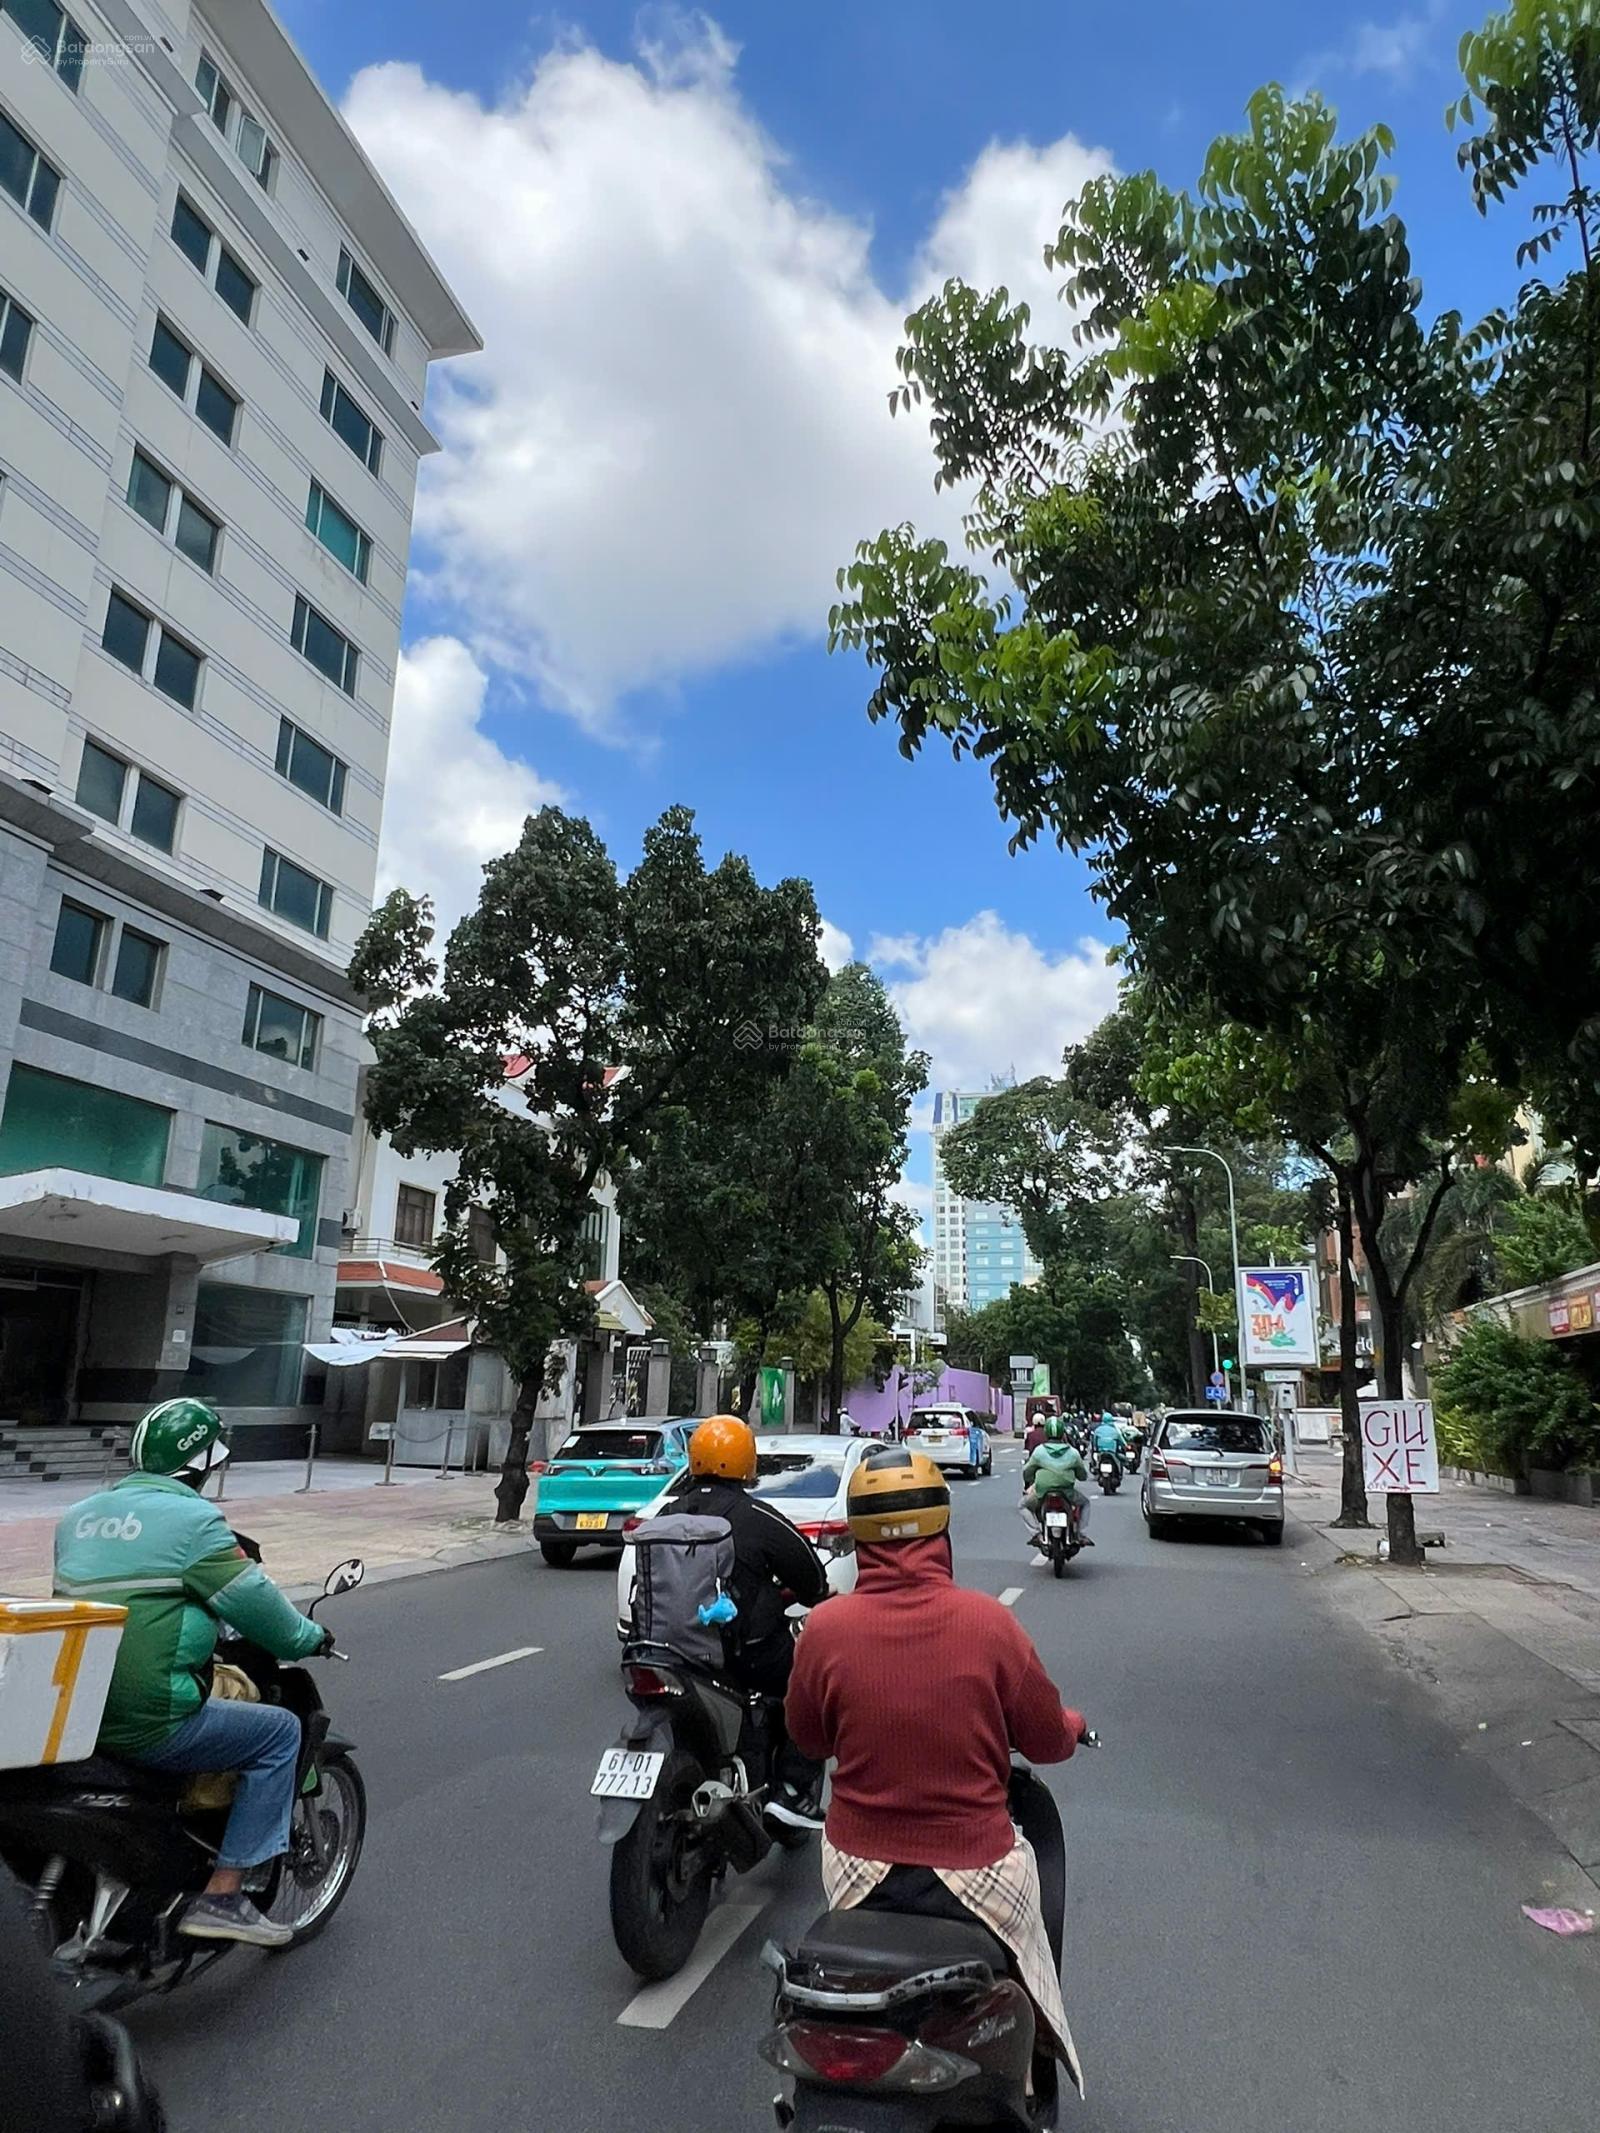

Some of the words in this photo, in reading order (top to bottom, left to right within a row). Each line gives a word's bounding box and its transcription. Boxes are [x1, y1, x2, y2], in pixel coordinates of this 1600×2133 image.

[177, 1424, 208, 1451] Grab
[1372, 1448, 1426, 1485] XE
[76, 1512, 142, 1541] Grab
[594, 1773, 652, 1795] 777.13
